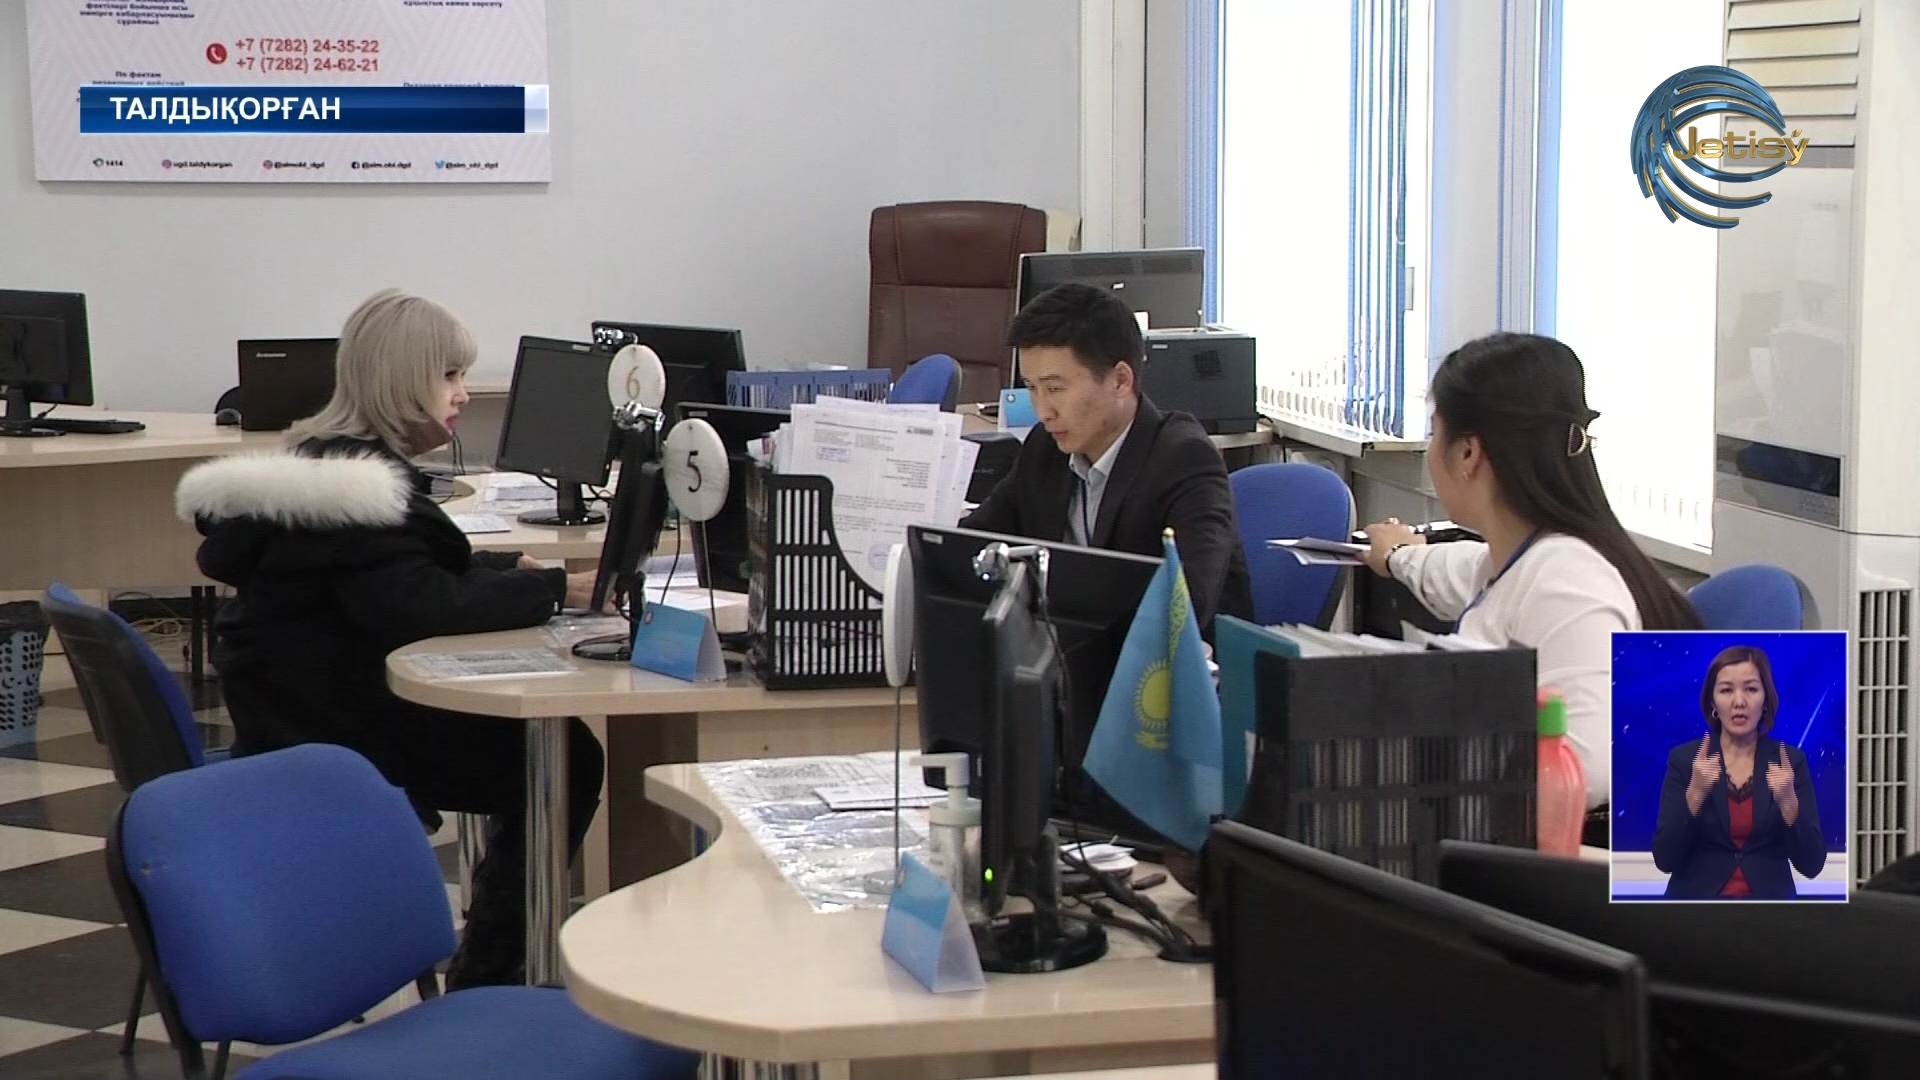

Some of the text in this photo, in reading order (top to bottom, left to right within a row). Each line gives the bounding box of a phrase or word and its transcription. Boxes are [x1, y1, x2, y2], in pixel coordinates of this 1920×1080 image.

[235, 38, 380, 54] +7 (7282) 24-35-22
[236, 57, 379, 73] +7 (7282) 24-62-21
[626, 365, 641, 400] 6
[686, 450, 702, 493] 5
